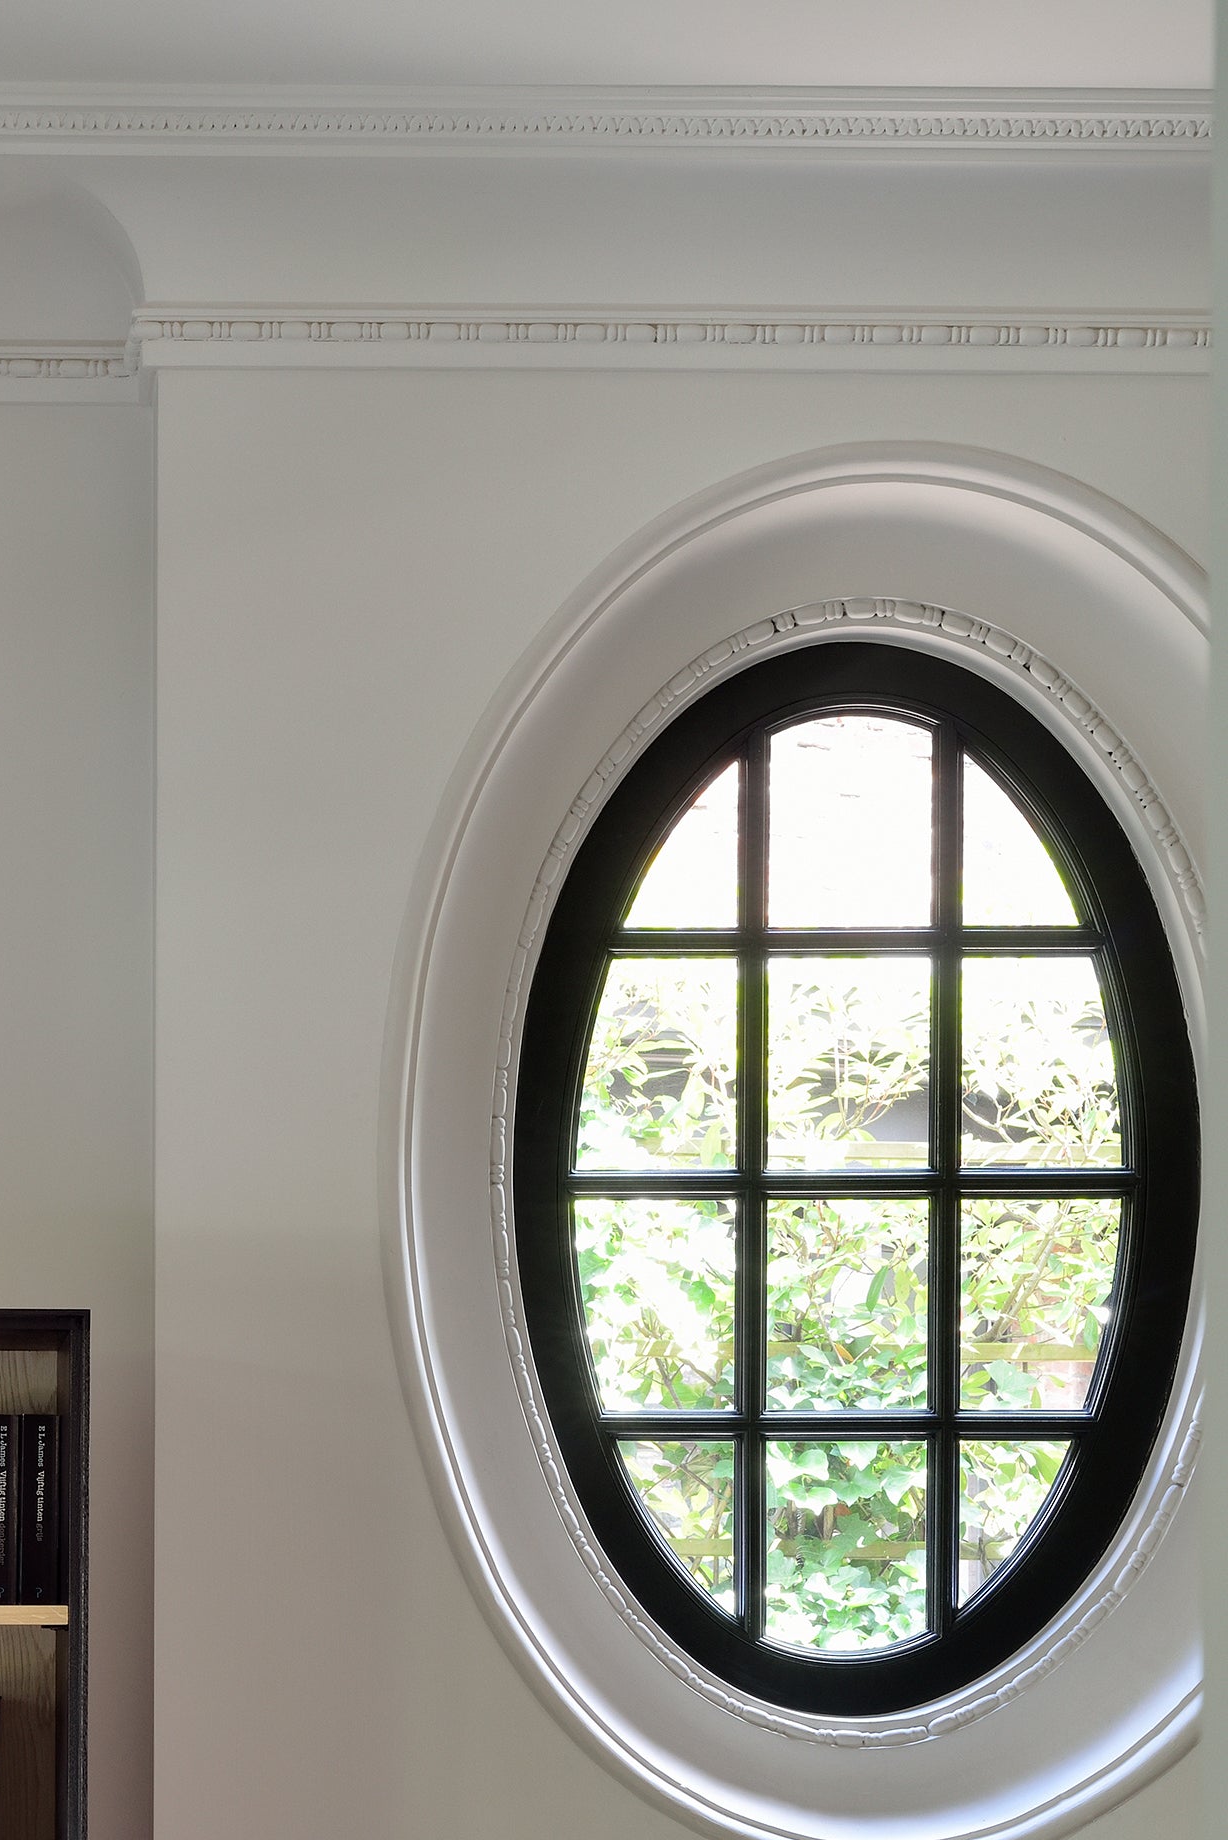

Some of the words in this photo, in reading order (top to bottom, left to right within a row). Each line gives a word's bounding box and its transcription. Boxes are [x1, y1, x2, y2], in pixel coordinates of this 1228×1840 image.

[0, 1432, 8, 1440] L
[38, 1432, 46, 1440] L
[0, 1440, 8, 1467] James
[38, 1440, 46, 1467] James
[36, 1470, 45, 1496] Vijftig
[0, 1496, 7, 1522] tinten
[36, 1496, 44, 1522] tinten
